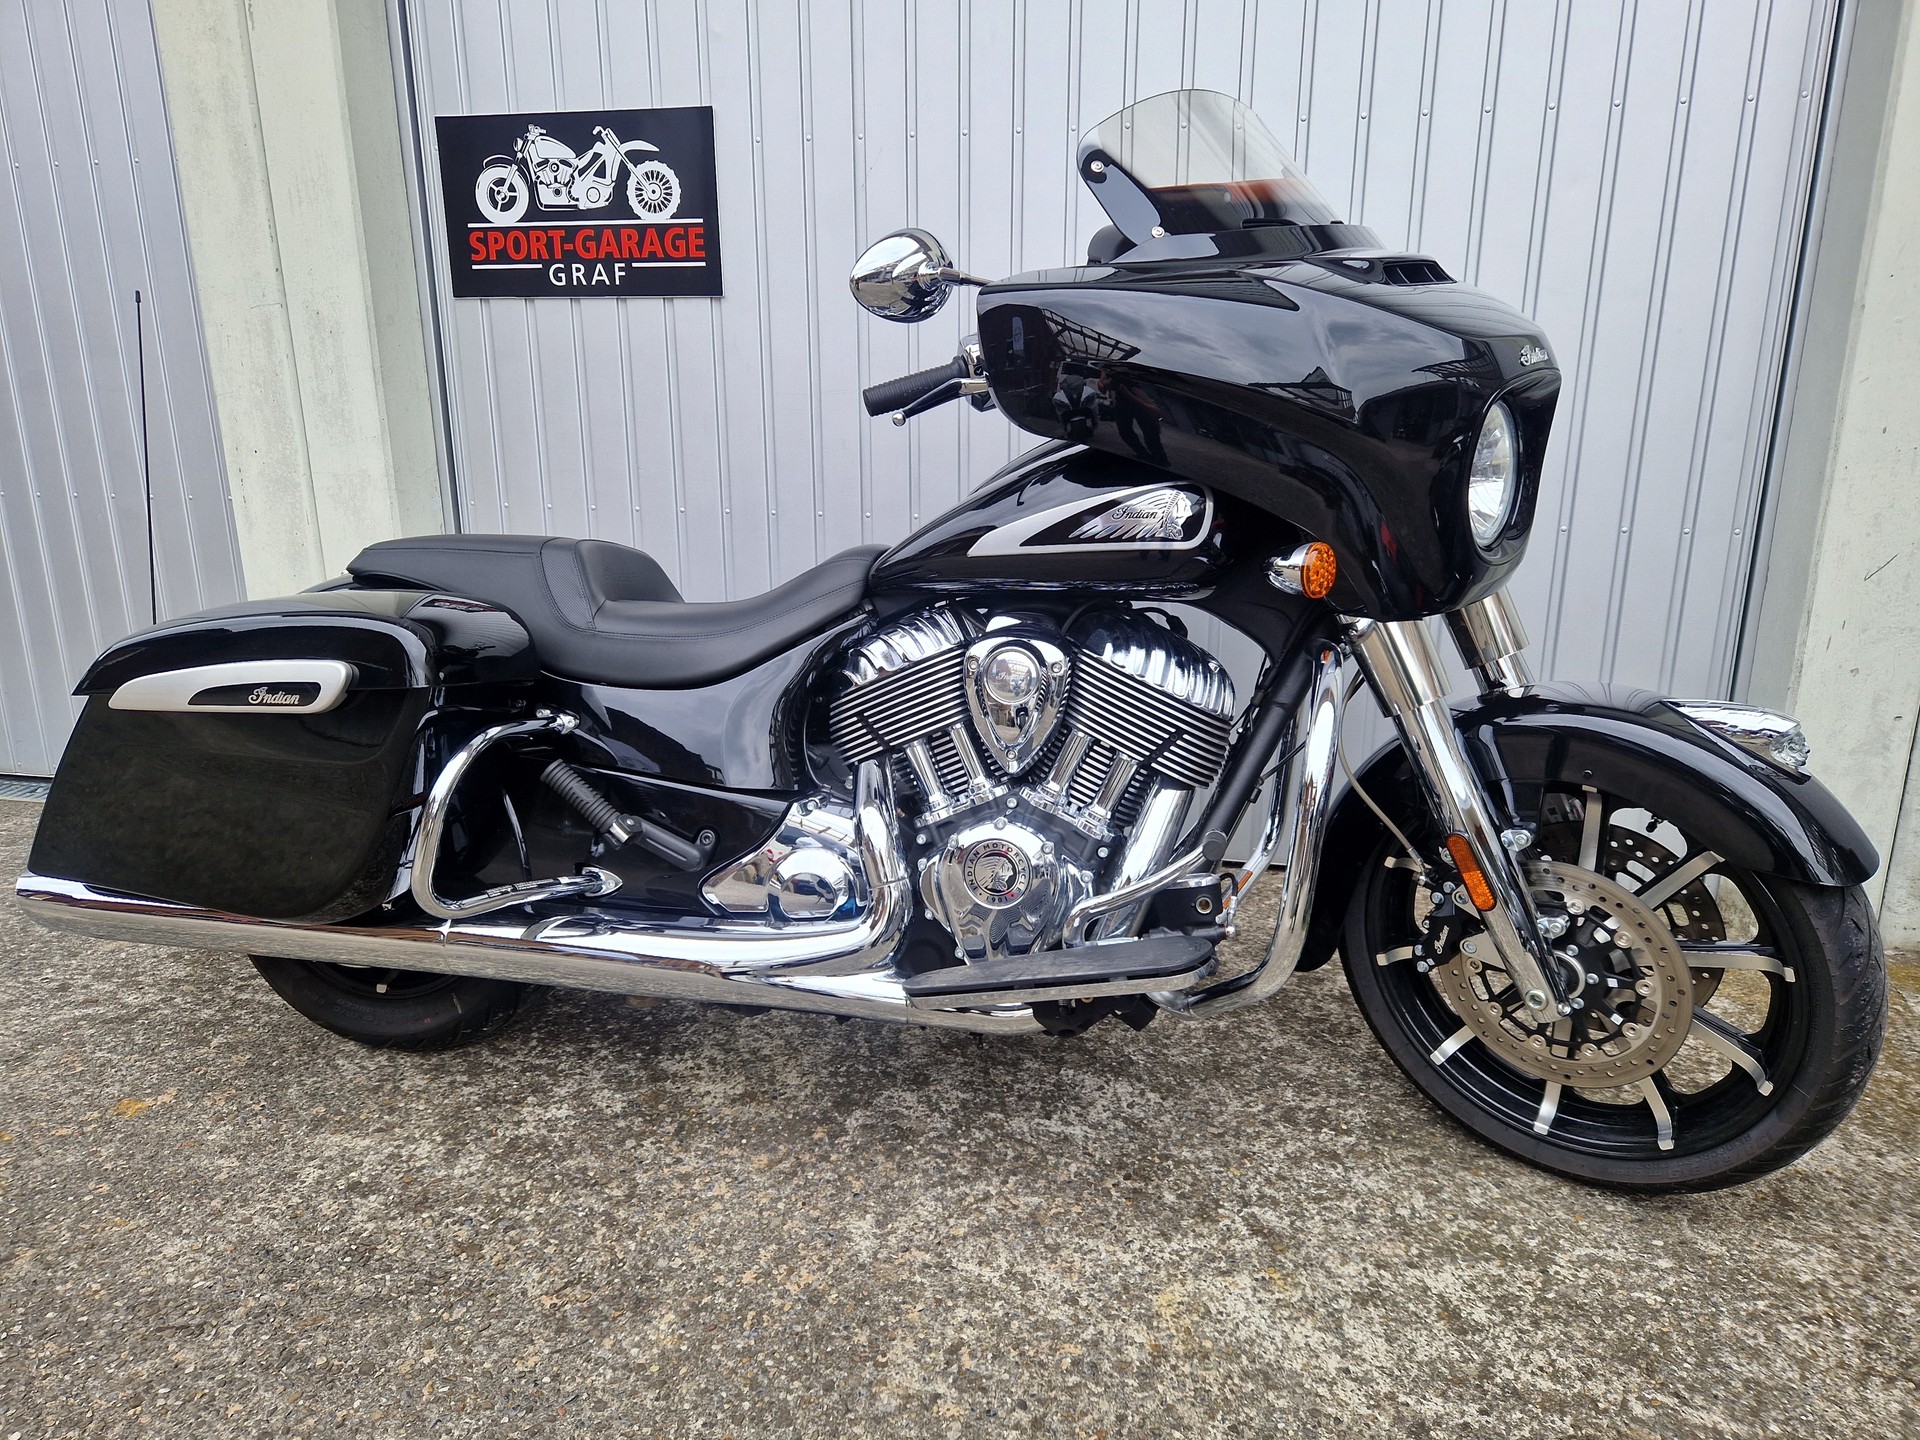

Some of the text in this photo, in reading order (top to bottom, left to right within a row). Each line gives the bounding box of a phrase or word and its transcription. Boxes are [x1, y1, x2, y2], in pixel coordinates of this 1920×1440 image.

[468, 227, 706, 261] SPORT-GARAGE
[549, 263, 626, 286] GRAF
[1111, 506, 1158, 520] Indian
[248, 686, 300, 705] Indian
[967, 842, 1027, 893] INDIAN MOTORCYCLE
[1434, 925, 1450, 954] Indian
